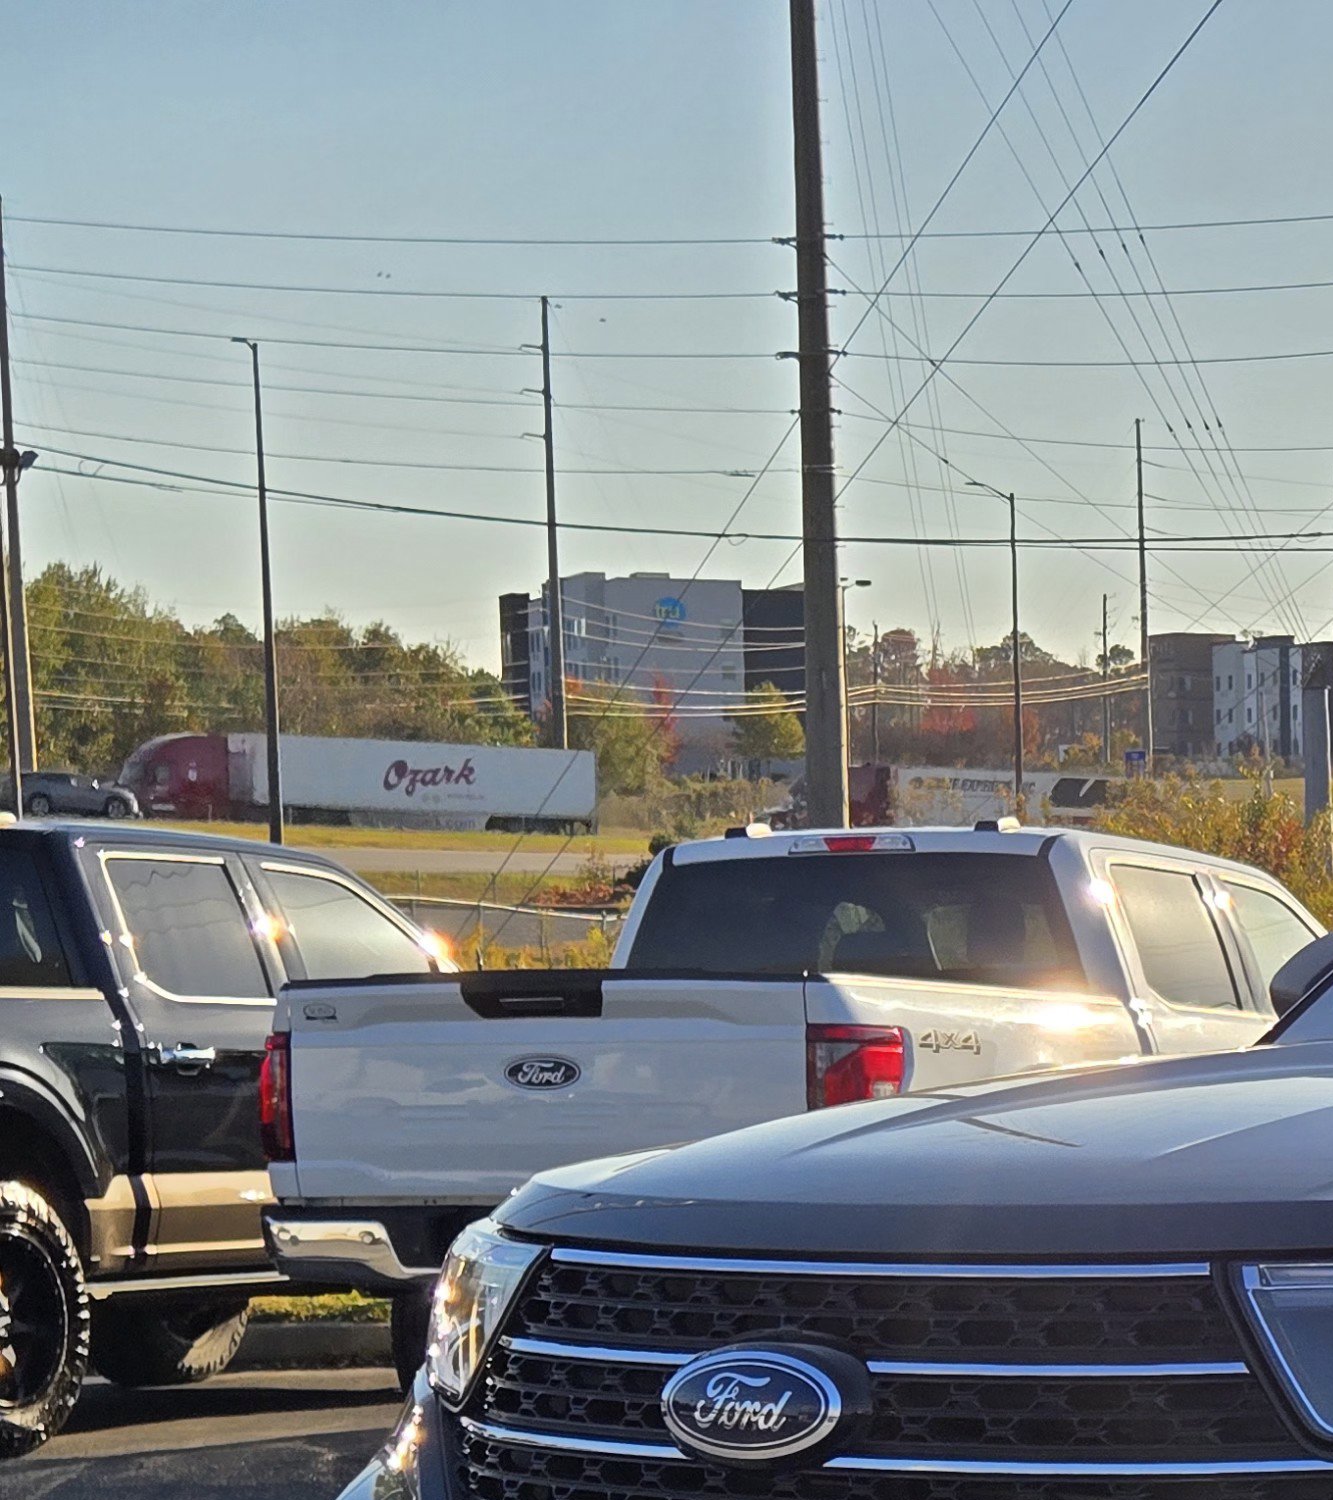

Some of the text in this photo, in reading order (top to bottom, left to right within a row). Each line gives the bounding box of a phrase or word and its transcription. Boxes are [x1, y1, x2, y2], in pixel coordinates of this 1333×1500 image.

[655, 602, 680, 619] tru
[383, 757, 476, 797] Ozark
[517, 1062, 566, 1084] Ford
[694, 1371, 792, 1433] Ford
